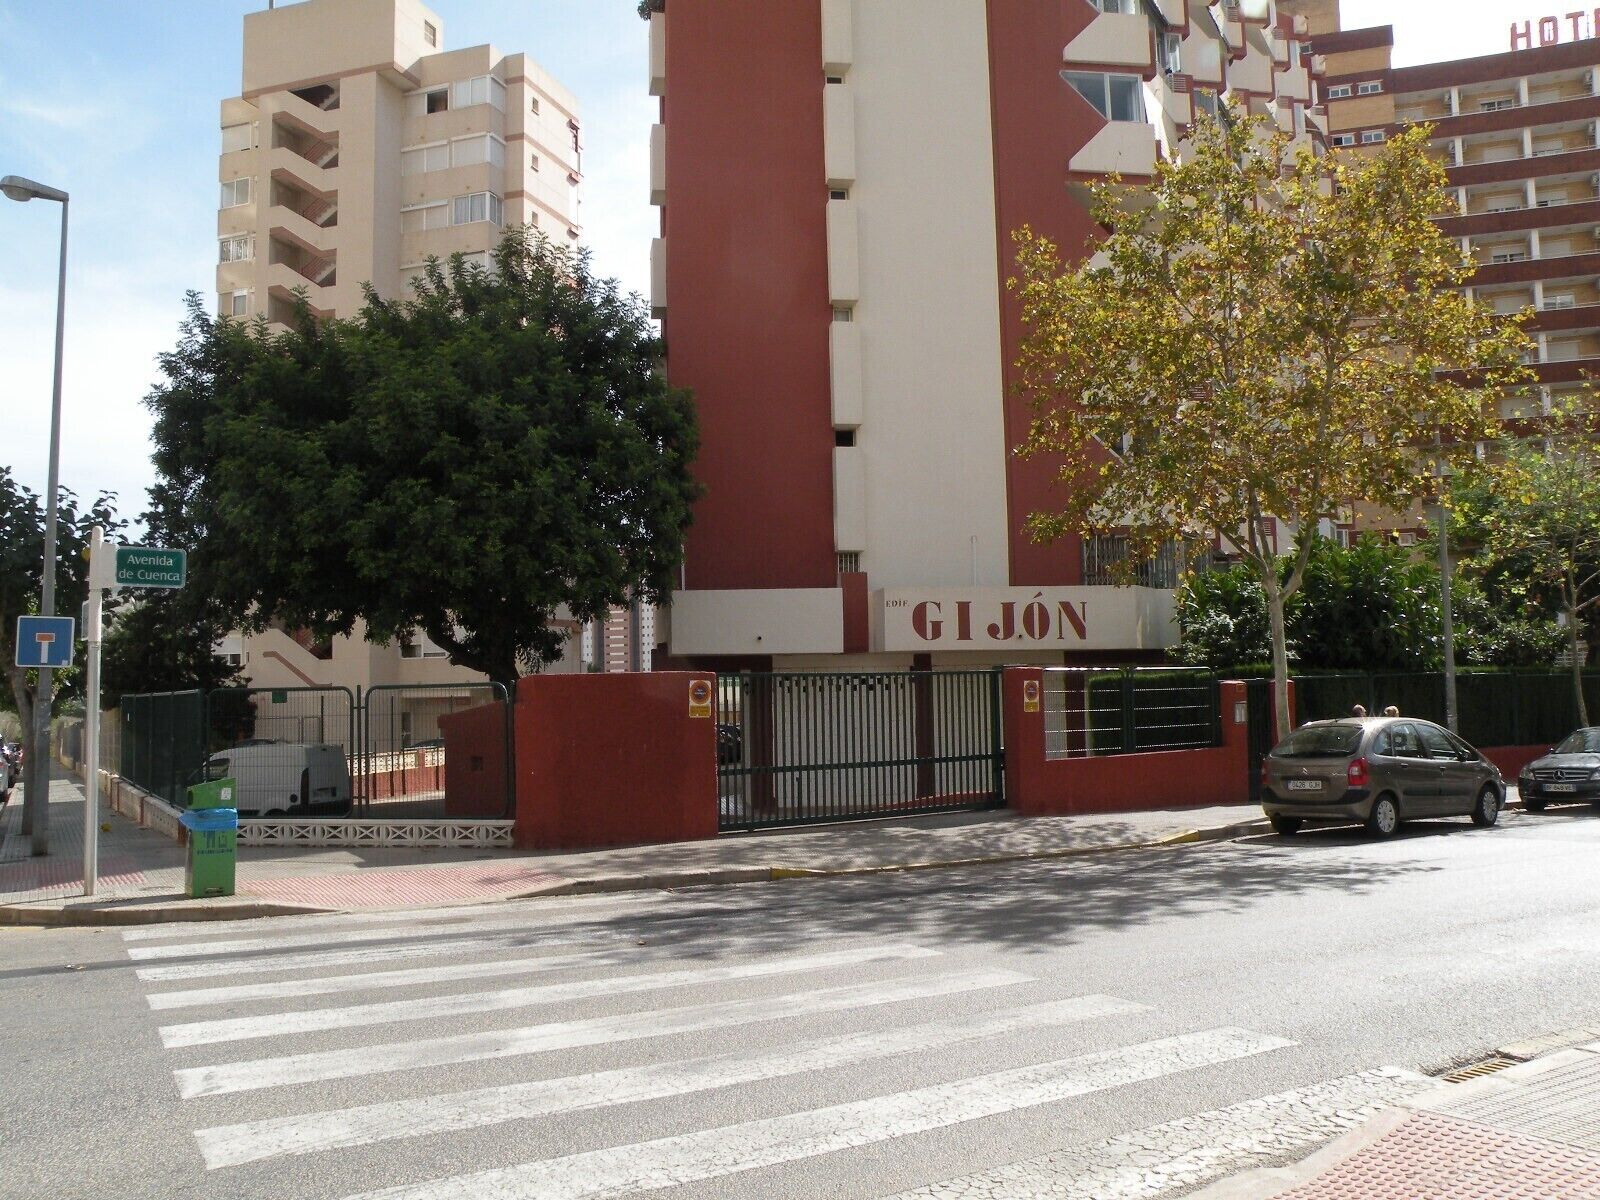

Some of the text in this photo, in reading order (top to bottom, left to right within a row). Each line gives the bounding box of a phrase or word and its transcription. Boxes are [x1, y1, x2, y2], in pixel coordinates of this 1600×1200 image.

[127, 554, 173, 566] Avenida
[119, 569, 180, 581] de Cuenca
[912, 591, 1087, 641] GIJÓN
